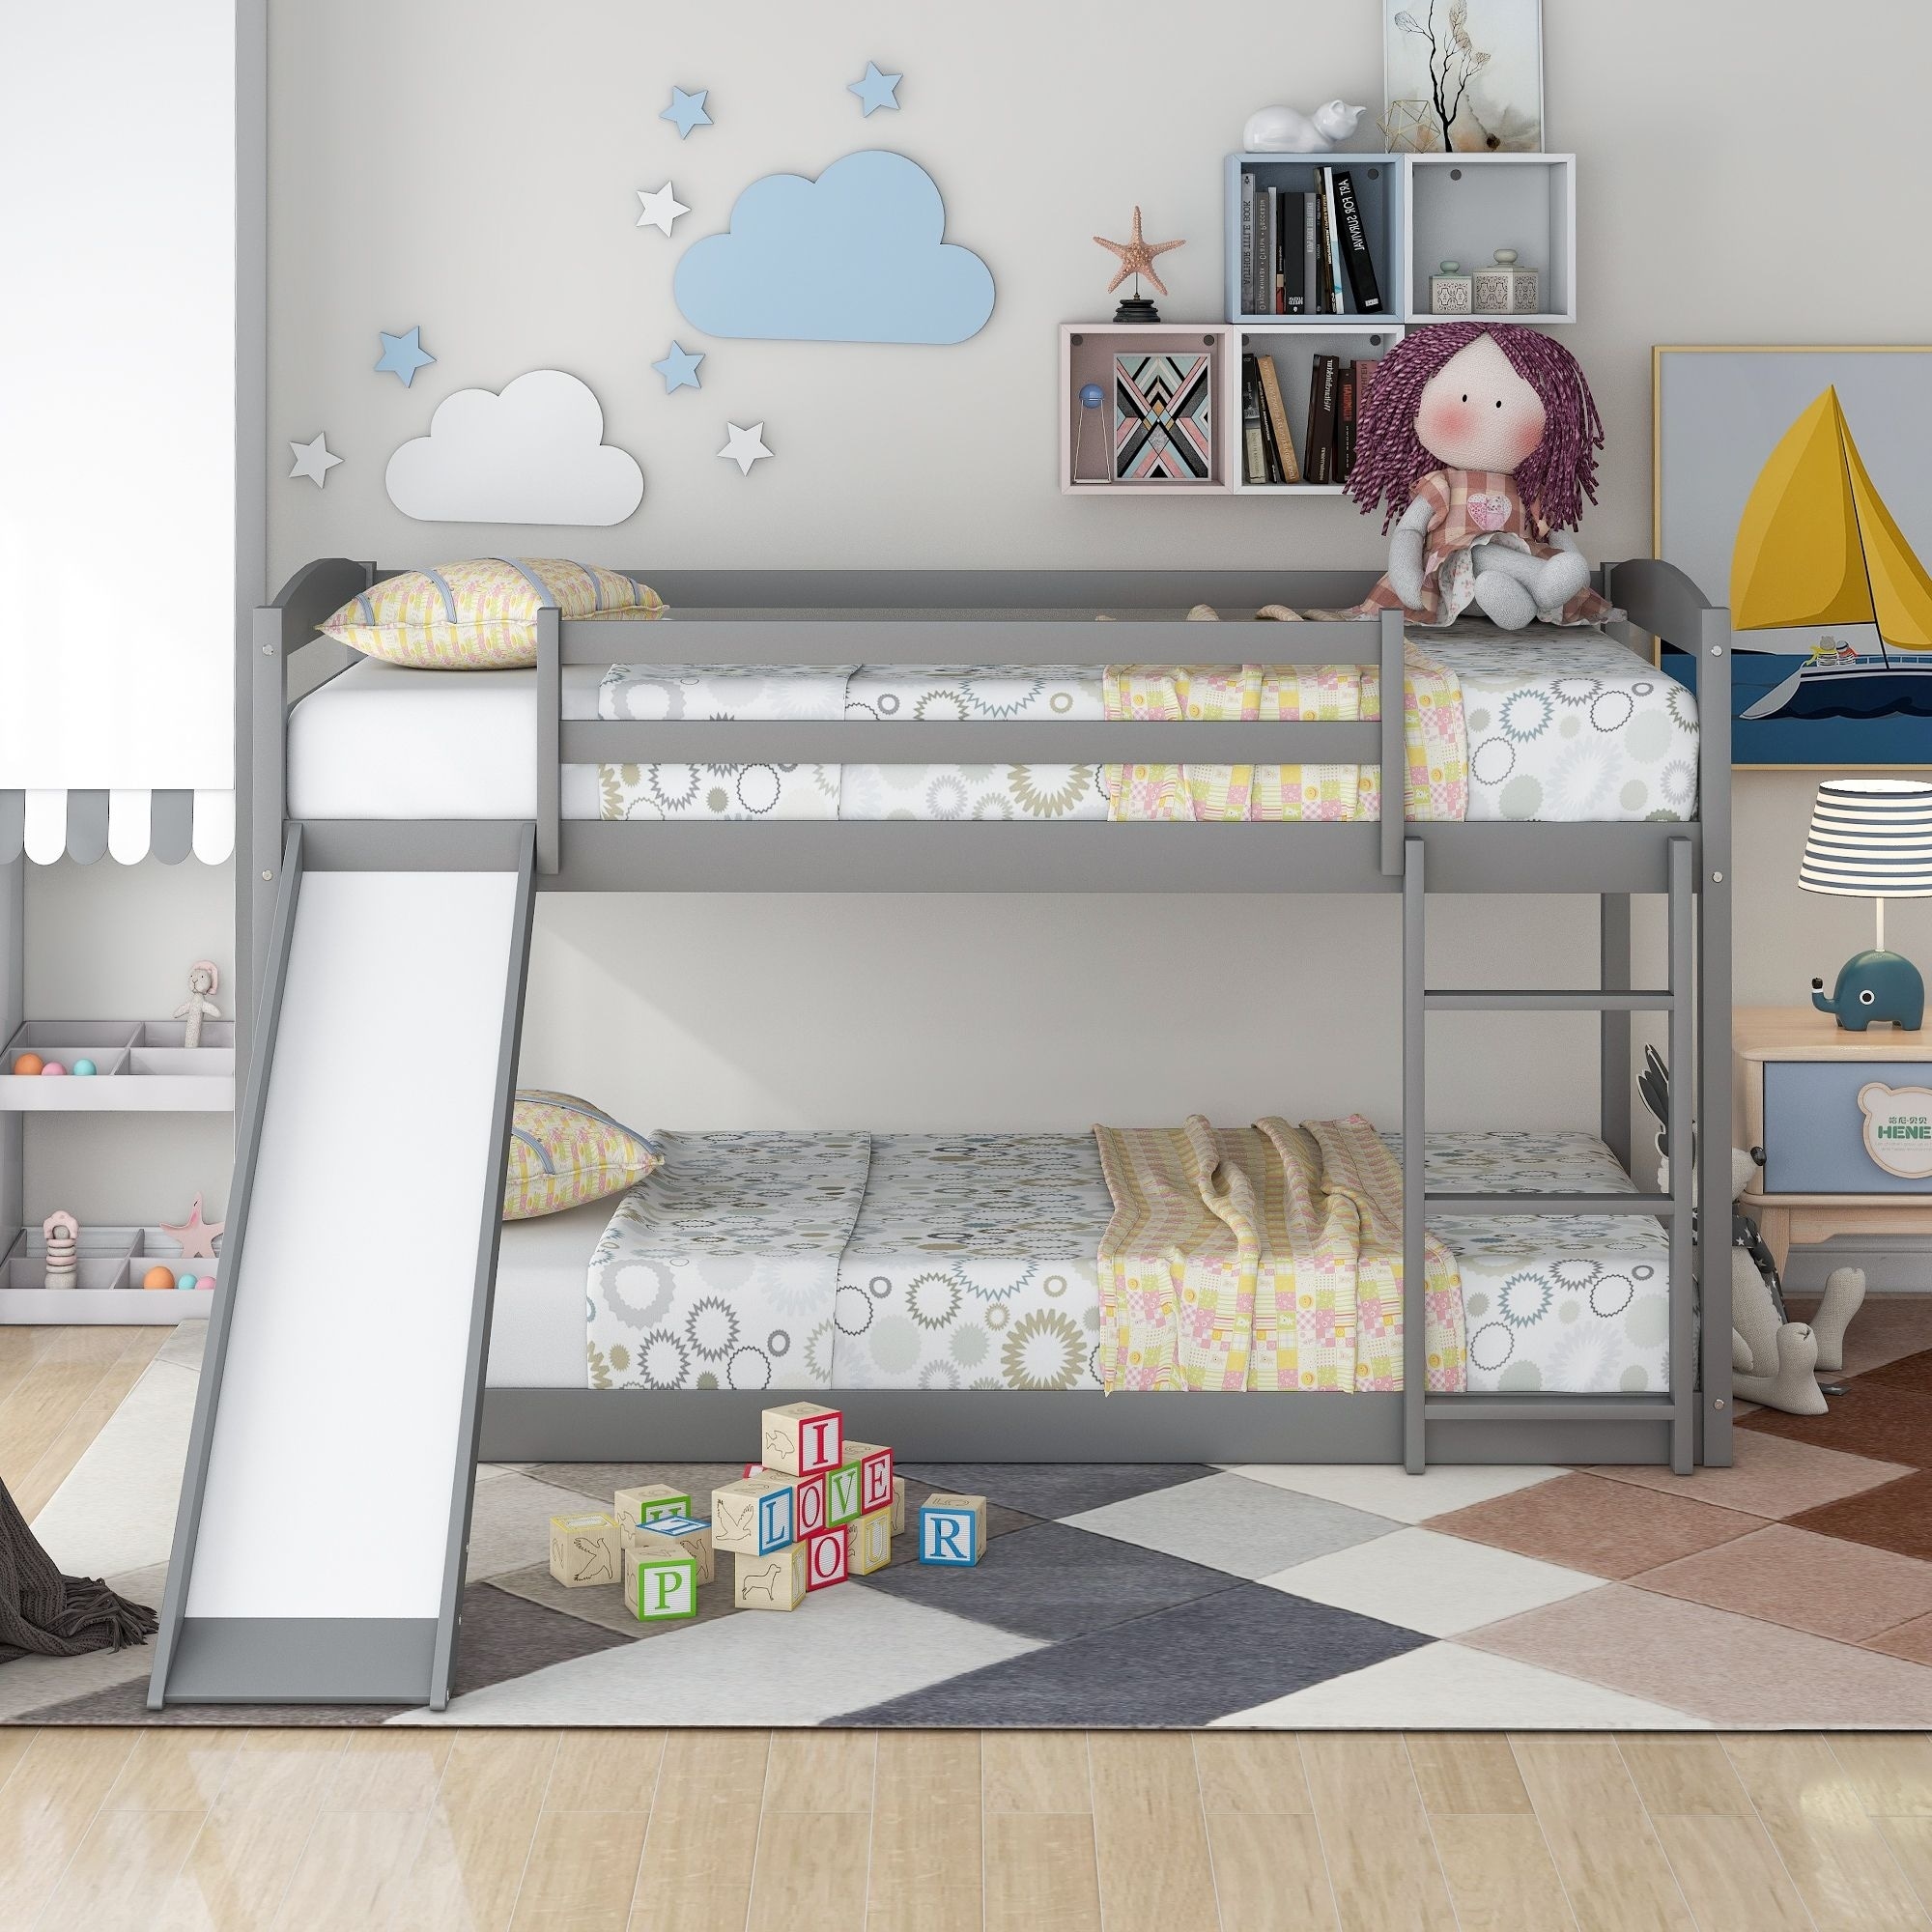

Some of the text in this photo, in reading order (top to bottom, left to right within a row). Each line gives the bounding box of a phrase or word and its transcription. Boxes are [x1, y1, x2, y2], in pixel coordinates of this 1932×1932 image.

[1878, 1125, 1931, 1139] HENE
[812, 1423, 829, 1465] I
[929, 1517, 968, 1559] R
[654, 1570, 684, 1610] P
